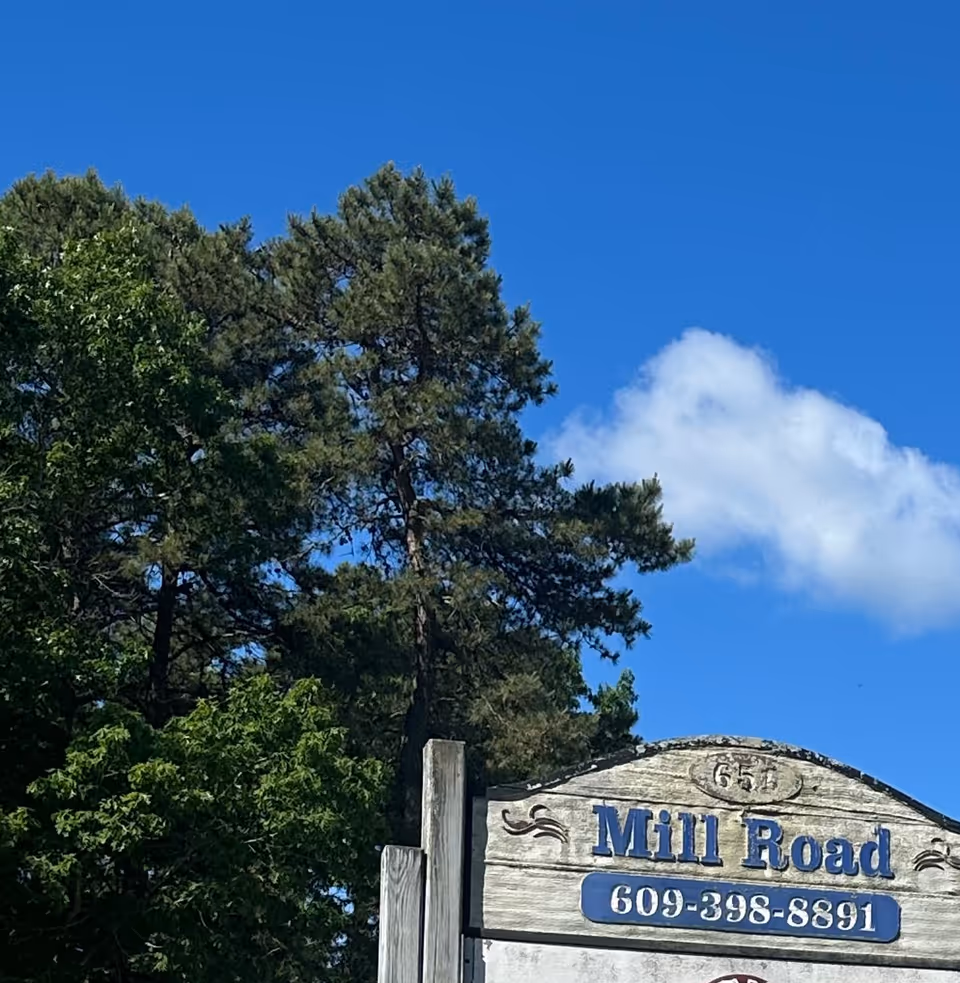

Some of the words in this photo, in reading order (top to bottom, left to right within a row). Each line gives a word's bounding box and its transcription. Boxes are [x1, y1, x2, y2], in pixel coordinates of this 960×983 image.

[592, 804, 723, 866] Mill
[742, 817, 895, 879] Road
[610, 885, 876, 933] 609-398-8891
